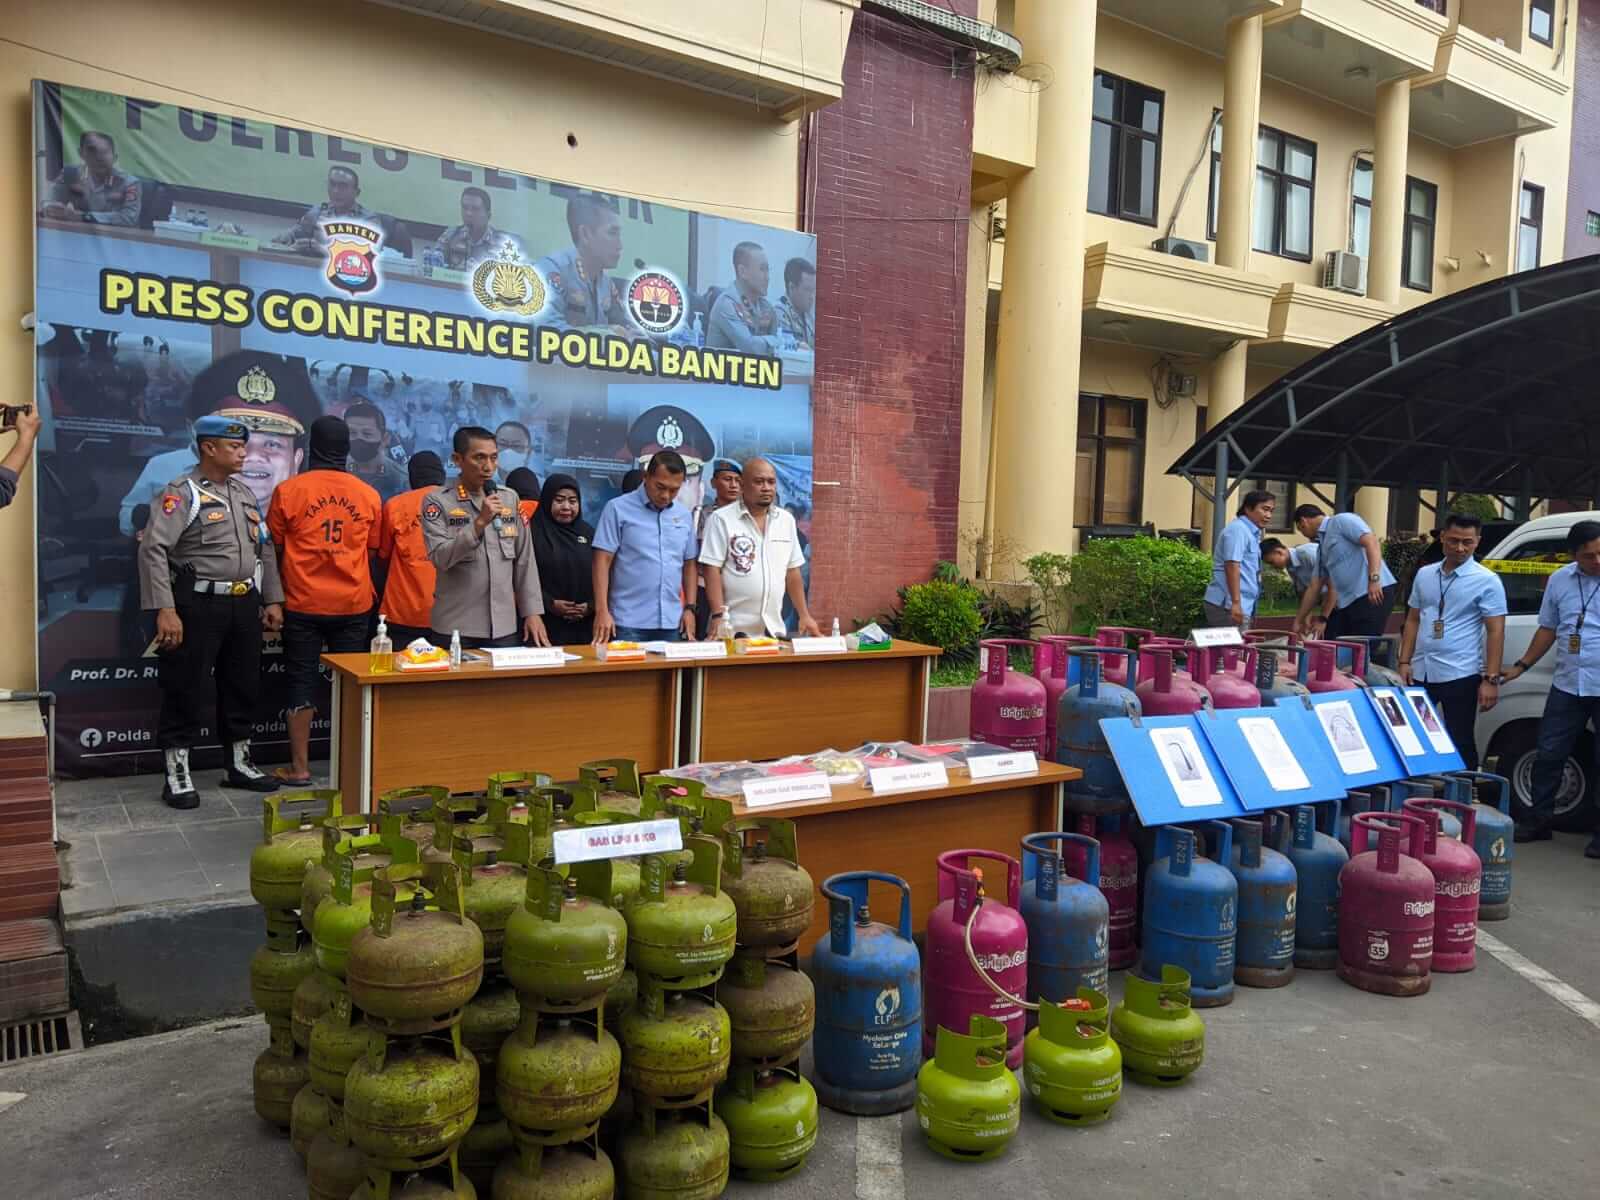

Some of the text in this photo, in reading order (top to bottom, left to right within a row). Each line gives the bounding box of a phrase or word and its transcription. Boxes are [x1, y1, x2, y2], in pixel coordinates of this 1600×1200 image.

[328, 224, 376, 240] BANTEN
[104, 272, 781, 388] PRESS CONFERENCE POLDA BANTEN
[304, 496, 361, 522] TAHANAN
[320, 518, 343, 544] 15
[71, 667, 110, 681] Prof.
[115, 666, 138, 680] Dr.
[107, 730, 151, 743] Polda
[1372, 945, 1386, 957] 35
